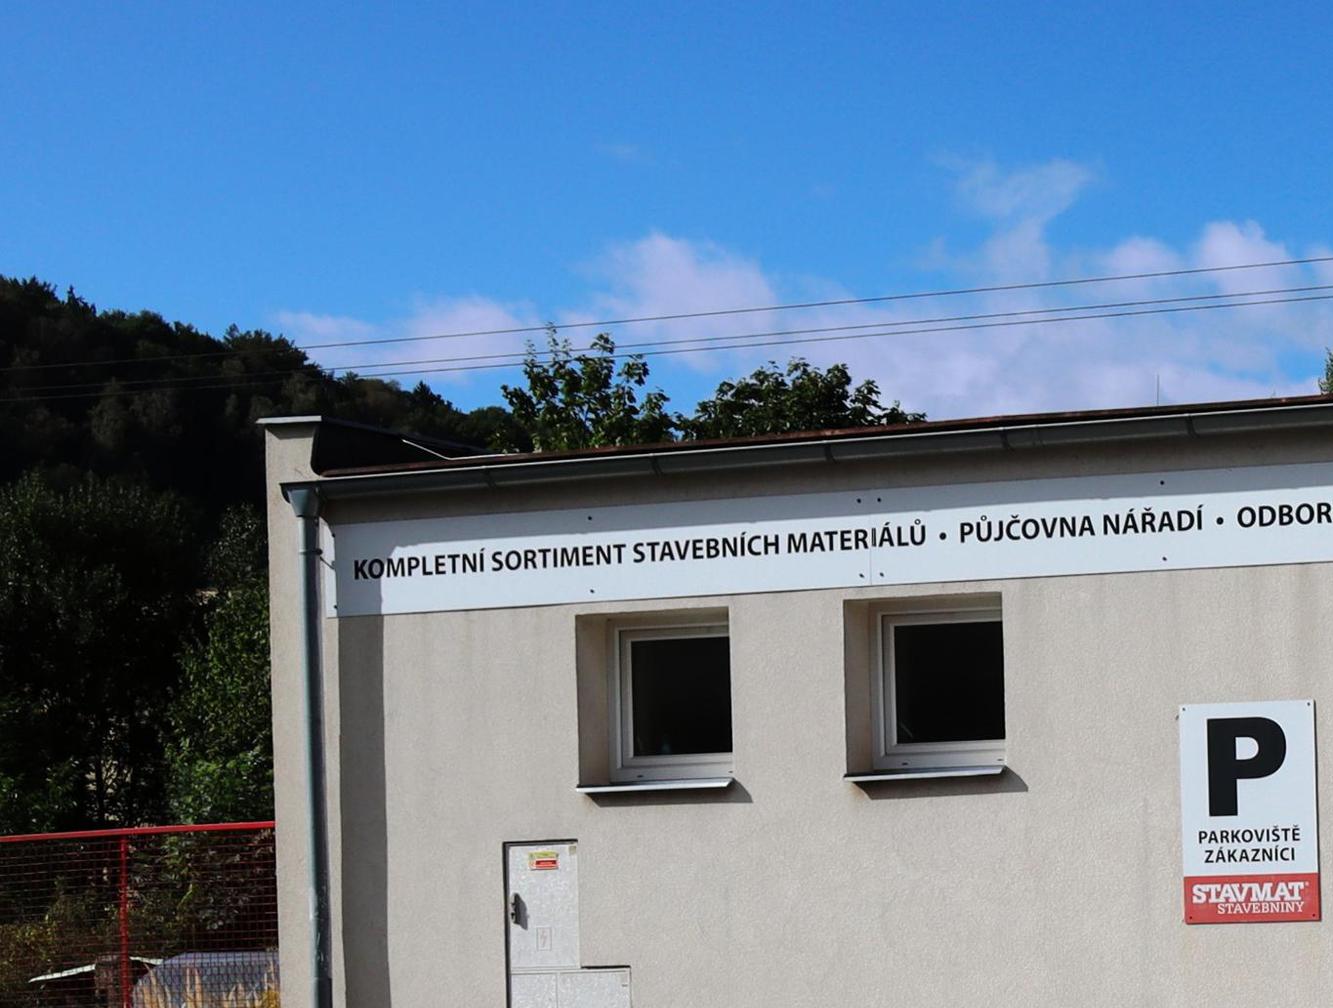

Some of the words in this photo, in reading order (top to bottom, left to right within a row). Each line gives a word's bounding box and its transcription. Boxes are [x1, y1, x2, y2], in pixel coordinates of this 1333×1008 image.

[353, 547, 485, 582] KOMPLETNÍ
[491, 543, 627, 573] SORTIMENT
[633, 534, 780, 565] STAVEBNÍCH
[787, 518, 927, 555] MATERIÁLŮ
[960, 513, 1096, 544] PŮJČOVNA
[1103, 504, 1204, 537] NÁŘADÍ
[1206, 716, 1287, 817] P
[1198, 824, 1301, 844] PARKOVIŠTĚ
[1204, 846, 1296, 864] ZÁKAZNÍCI
[1217, 901, 1305, 915] STAVEBNINY
